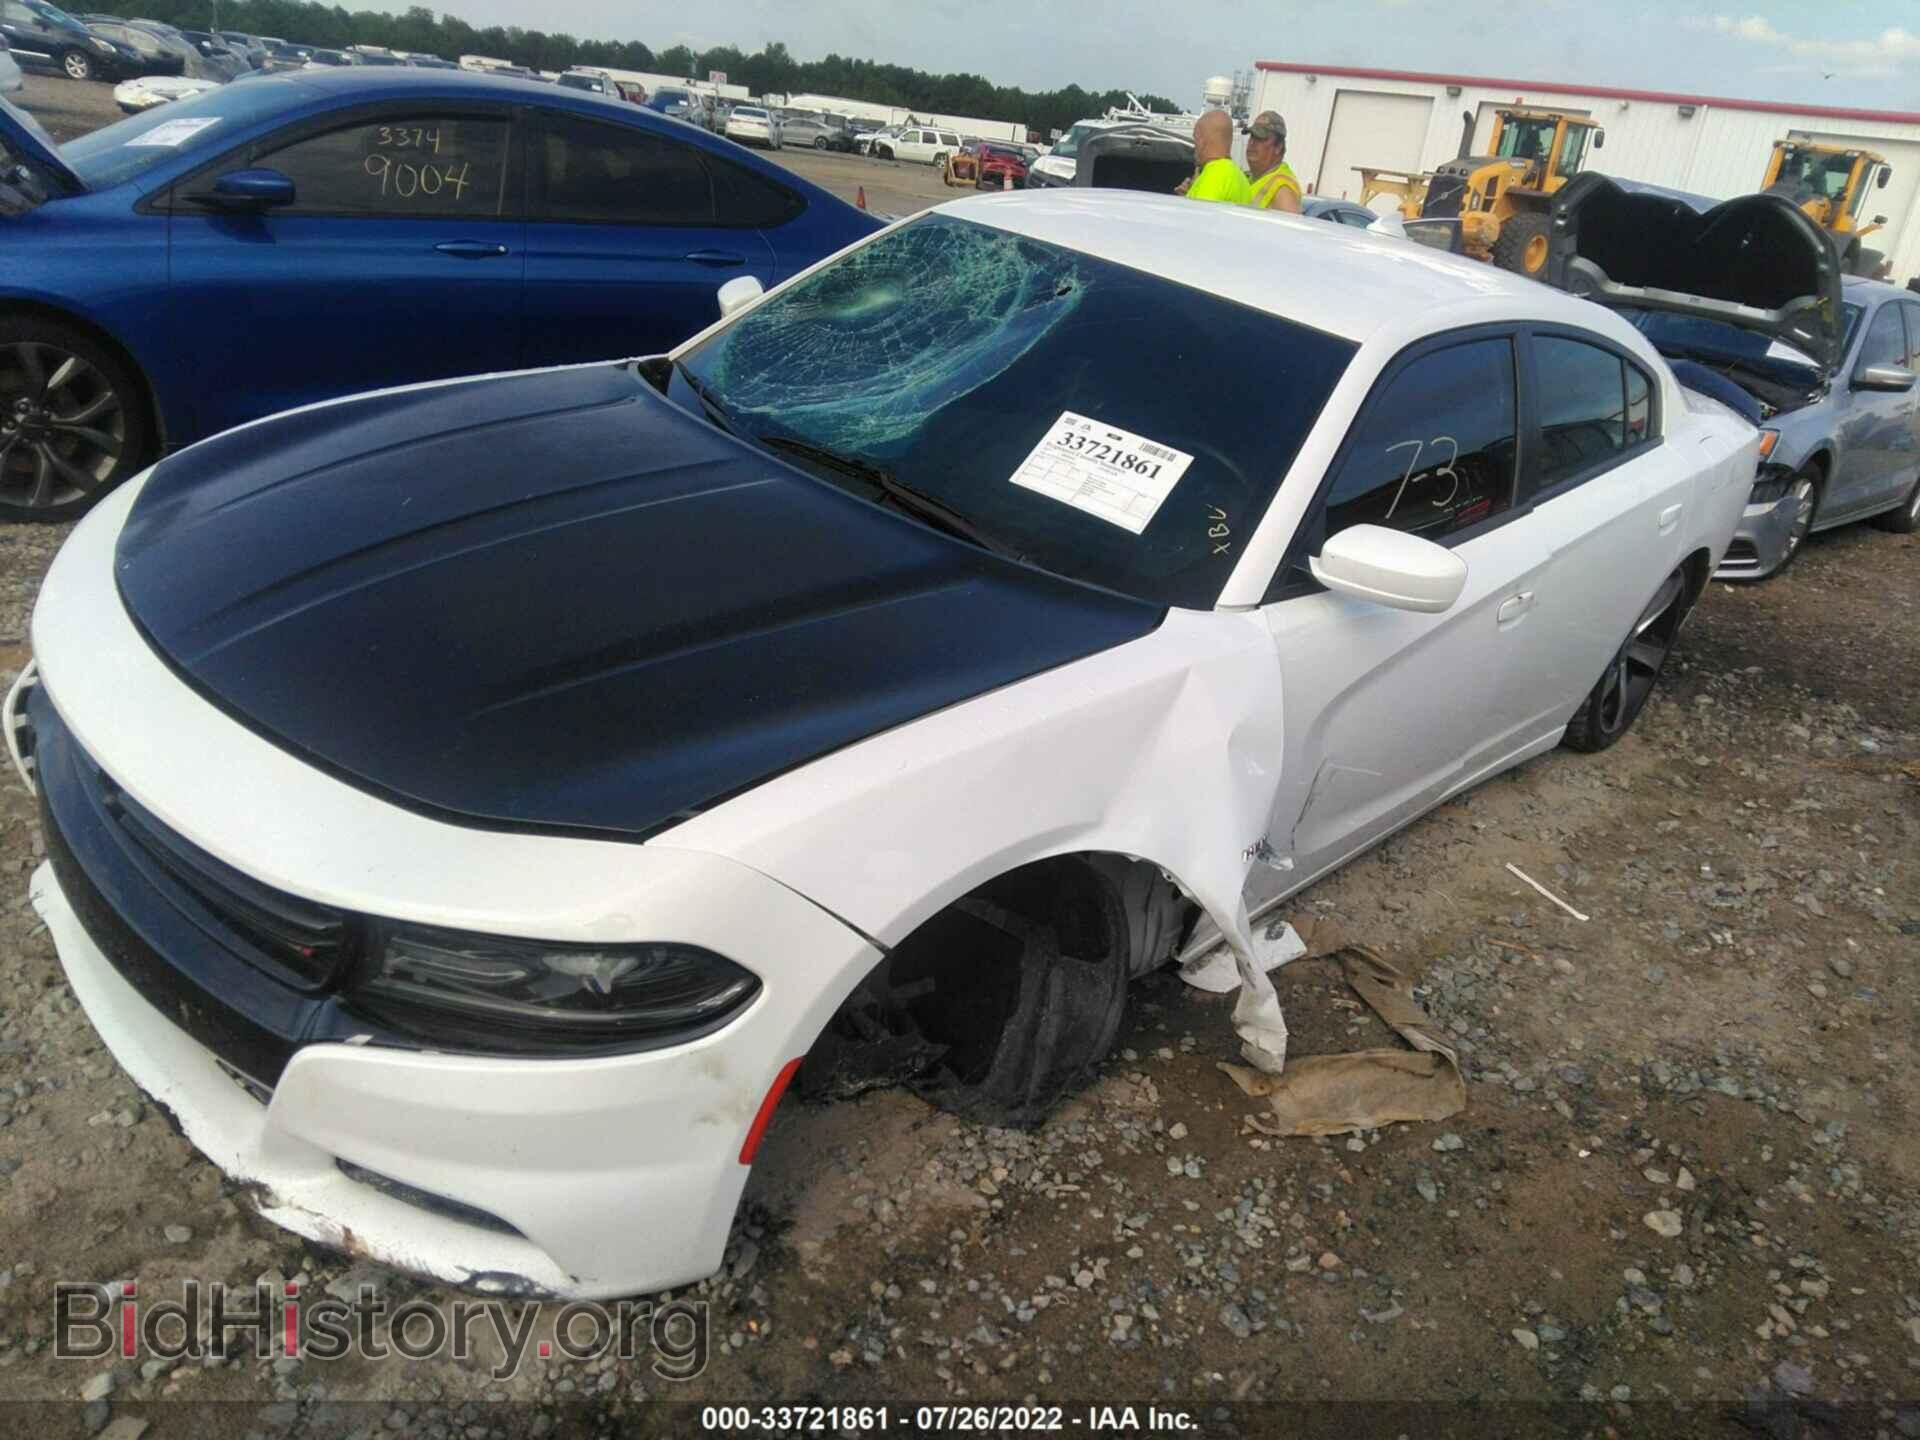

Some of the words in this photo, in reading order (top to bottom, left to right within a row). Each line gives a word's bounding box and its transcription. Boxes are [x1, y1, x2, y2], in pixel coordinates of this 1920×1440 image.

[378, 126, 440, 153] 3374
[364, 153, 470, 200] 9004
[1057, 431, 1163, 481] 33721861
